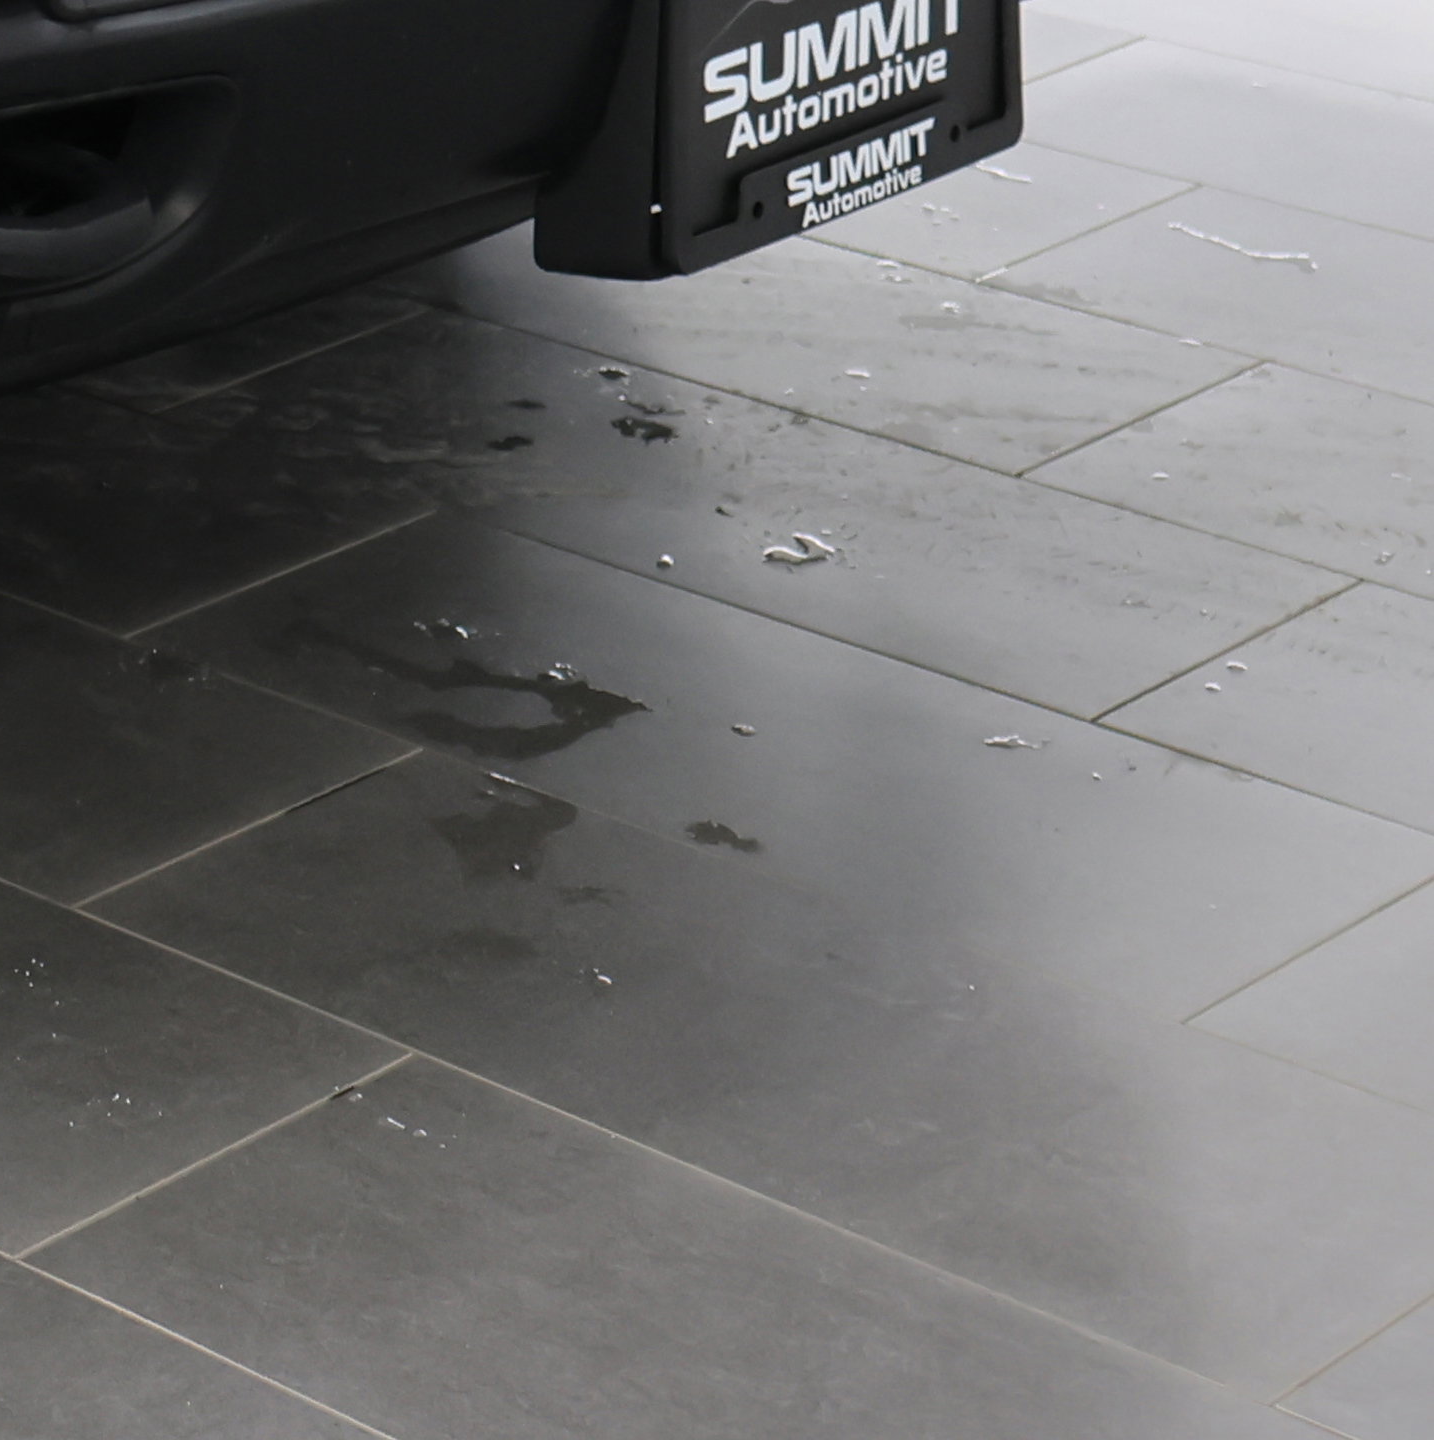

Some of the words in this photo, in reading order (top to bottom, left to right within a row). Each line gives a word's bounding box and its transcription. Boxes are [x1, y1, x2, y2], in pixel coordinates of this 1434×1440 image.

[725, 48, 948, 159] Automotive
[786, 117, 936, 207] SUMMIT
[801, 164, 923, 228] Automotive
